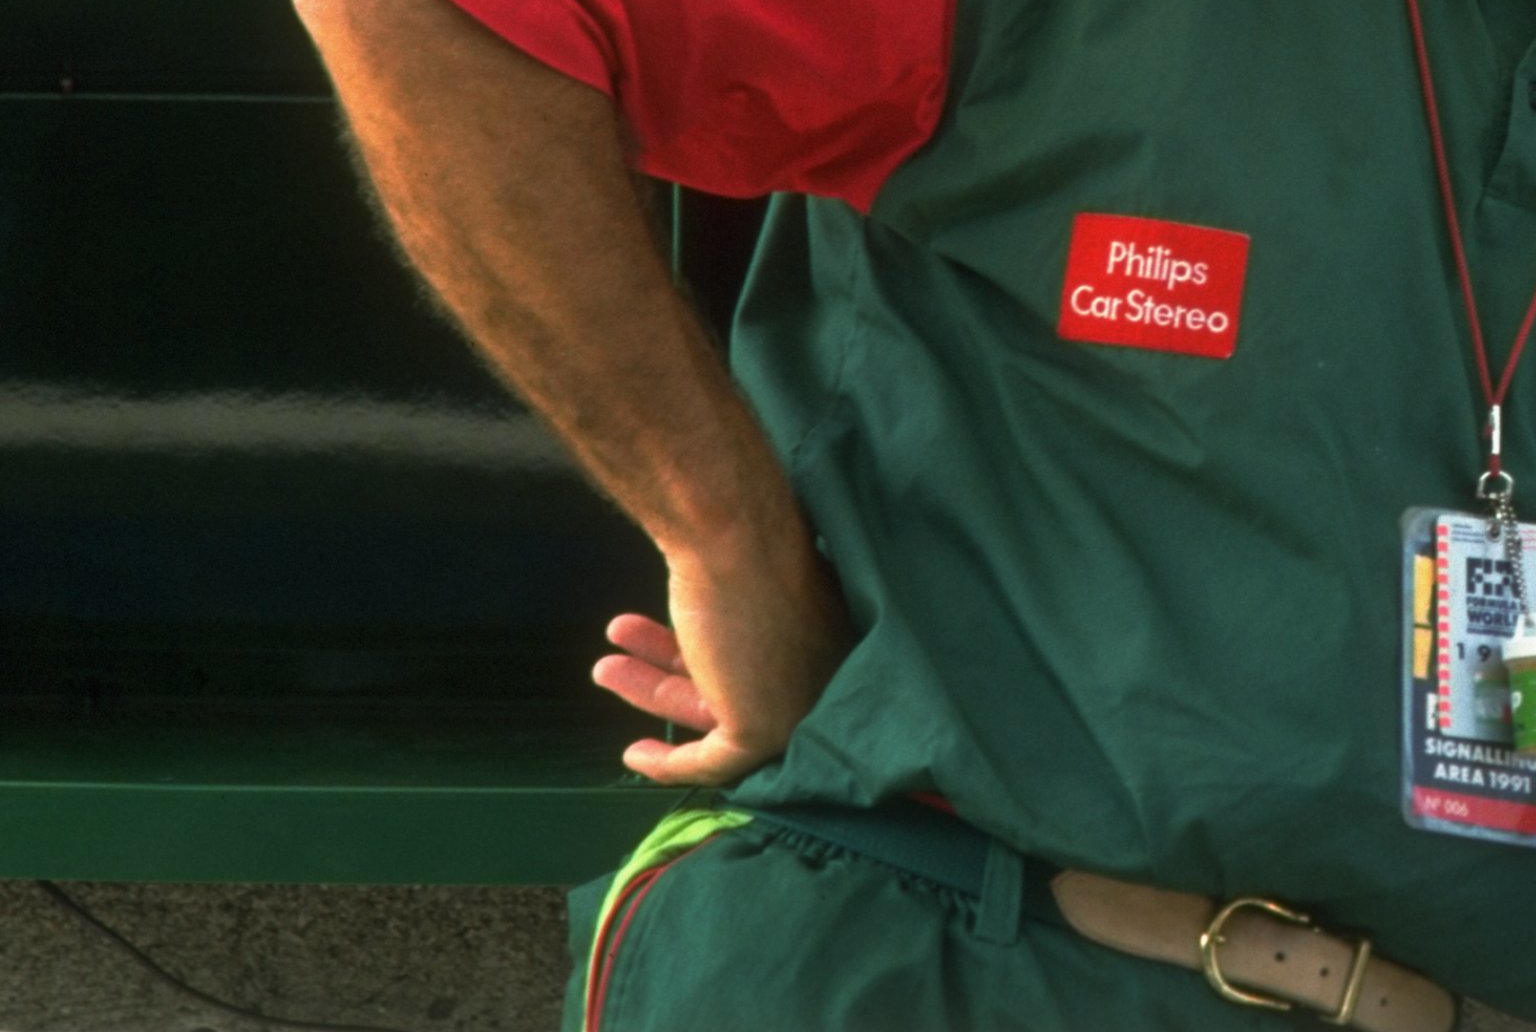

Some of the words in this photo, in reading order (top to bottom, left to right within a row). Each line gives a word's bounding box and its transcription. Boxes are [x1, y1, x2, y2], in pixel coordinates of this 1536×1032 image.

[1107, 241, 1209, 291] Philips
[1070, 285, 1123, 320] Car
[1124, 289, 1229, 333] Stereo
[1467, 610, 1518, 627] WORL
[1434, 763, 1485, 787] AREA
[1488, 771, 1532, 794] 1991
[1443, 800, 1469, 817] 006
